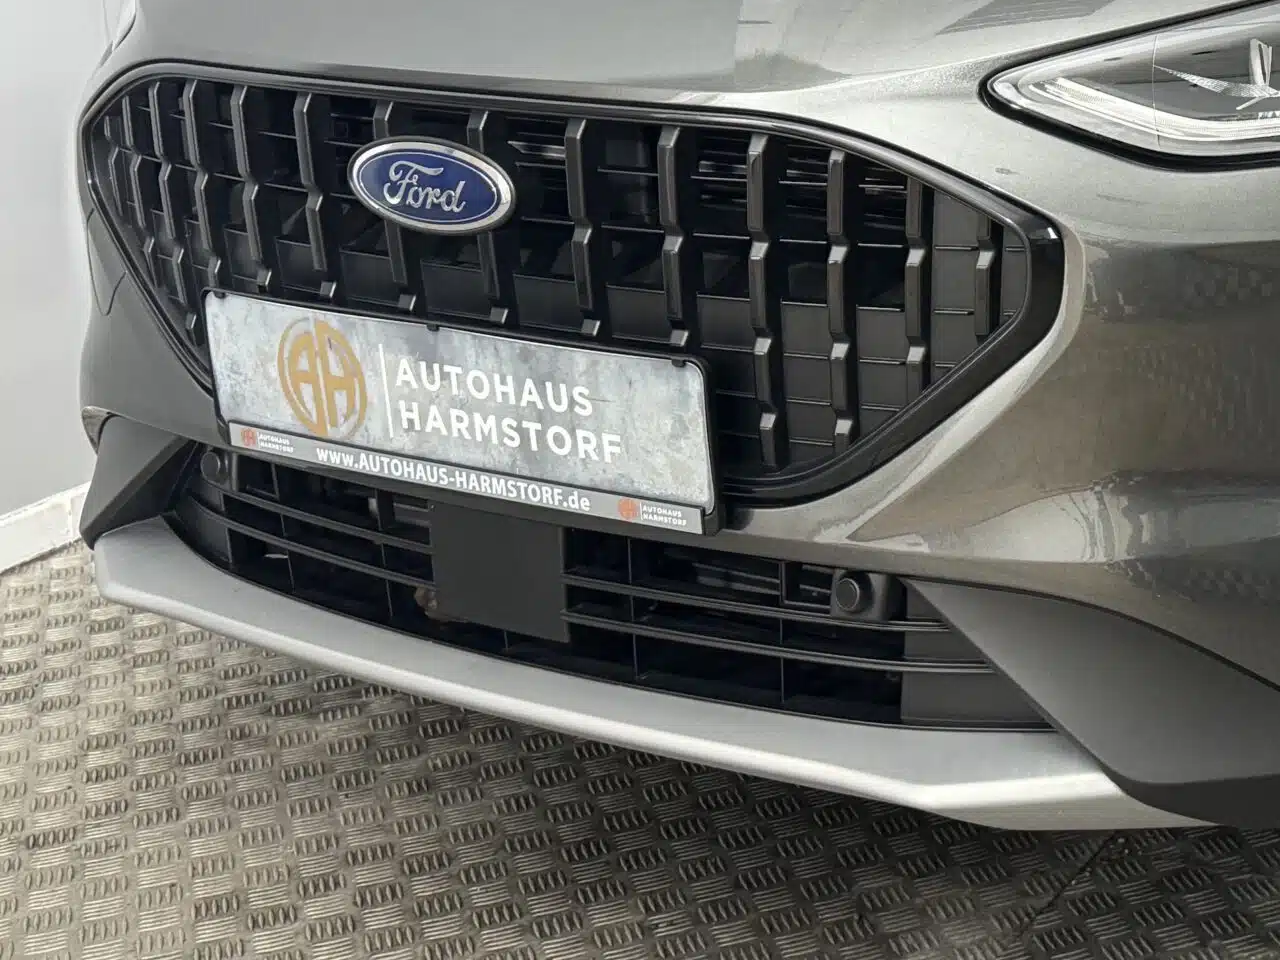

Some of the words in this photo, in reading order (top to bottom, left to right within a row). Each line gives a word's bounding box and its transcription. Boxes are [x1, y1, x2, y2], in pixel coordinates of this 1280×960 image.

[383, 160, 467, 213] Ford
[396, 357, 593, 417] AUTOHAUS
[398, 399, 622, 464] HARMSTORF
[316, 446, 592, 512] www.AUTOHAUS-HARMSTORF.de
[642, 504, 682, 518] AUTOHAUS
